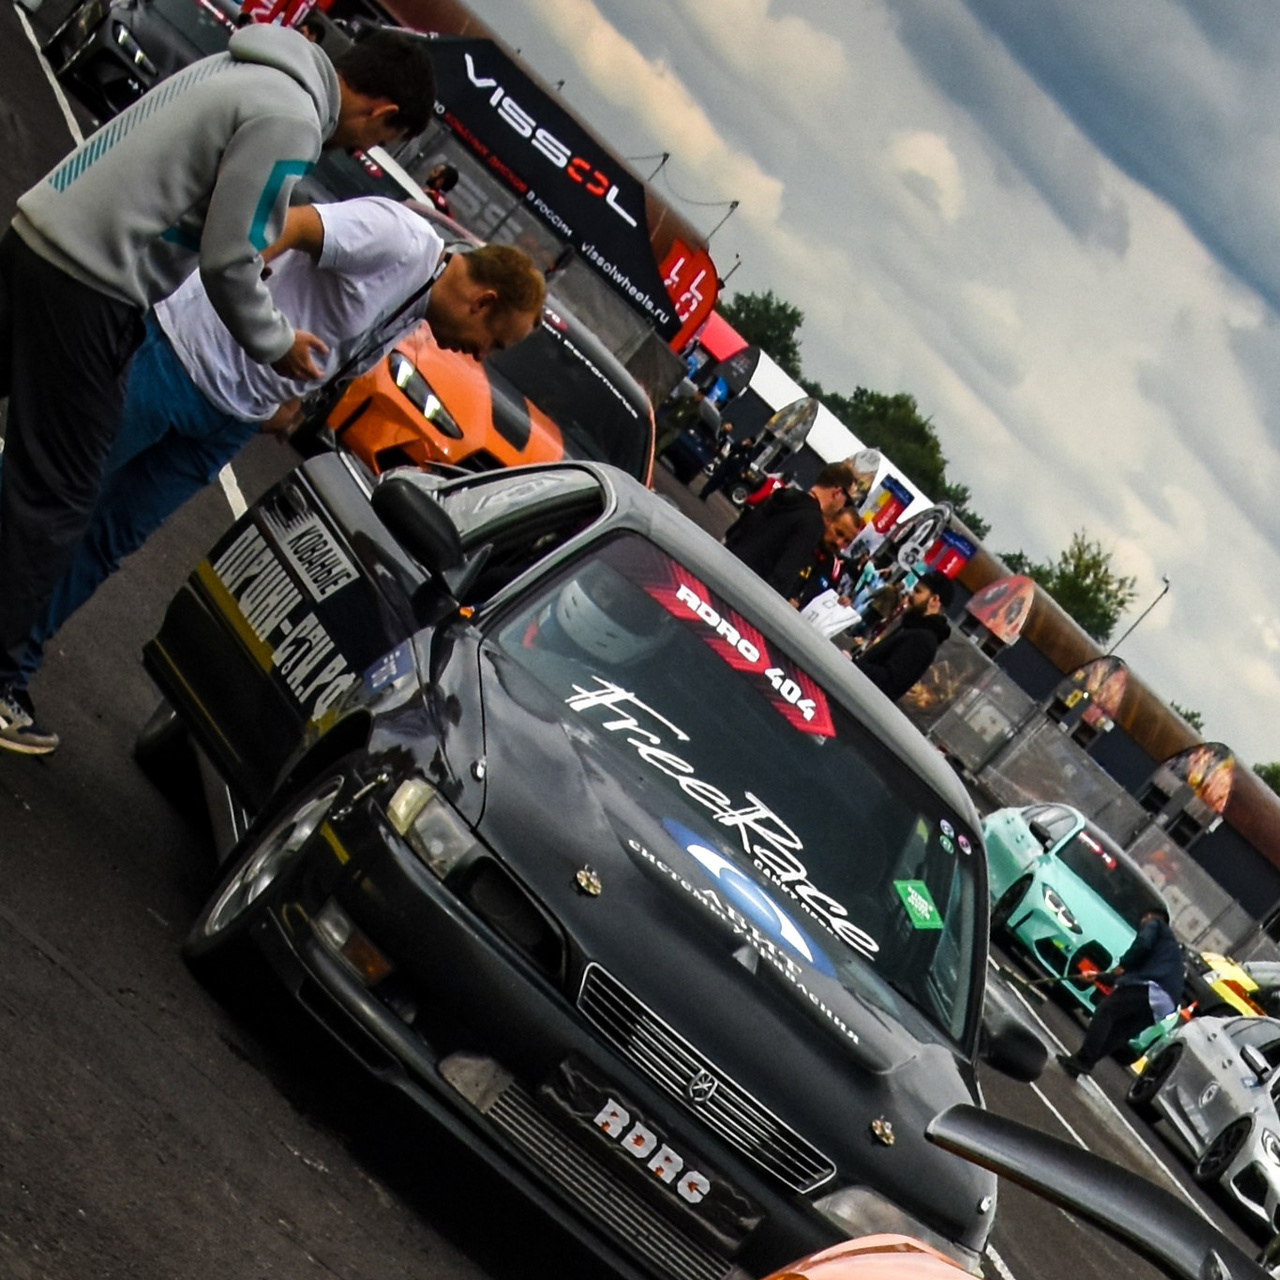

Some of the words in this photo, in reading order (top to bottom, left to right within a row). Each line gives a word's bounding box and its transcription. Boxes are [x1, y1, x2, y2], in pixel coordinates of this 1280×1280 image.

[467, 53, 637, 228] VISSOL
[534, 199, 573, 237] РОССИИ
[578, 240, 671, 325] vissolwheels.ru
[287, 525, 352, 595] КОВАНЫЕ
[677, 583, 761, 663] RDRC
[765, 667, 815, 721] 404
[565, 675, 880, 960] FreeRace
[694, 888, 803, 977] АВИТ
[592, 1097, 711, 1204] RDRC
